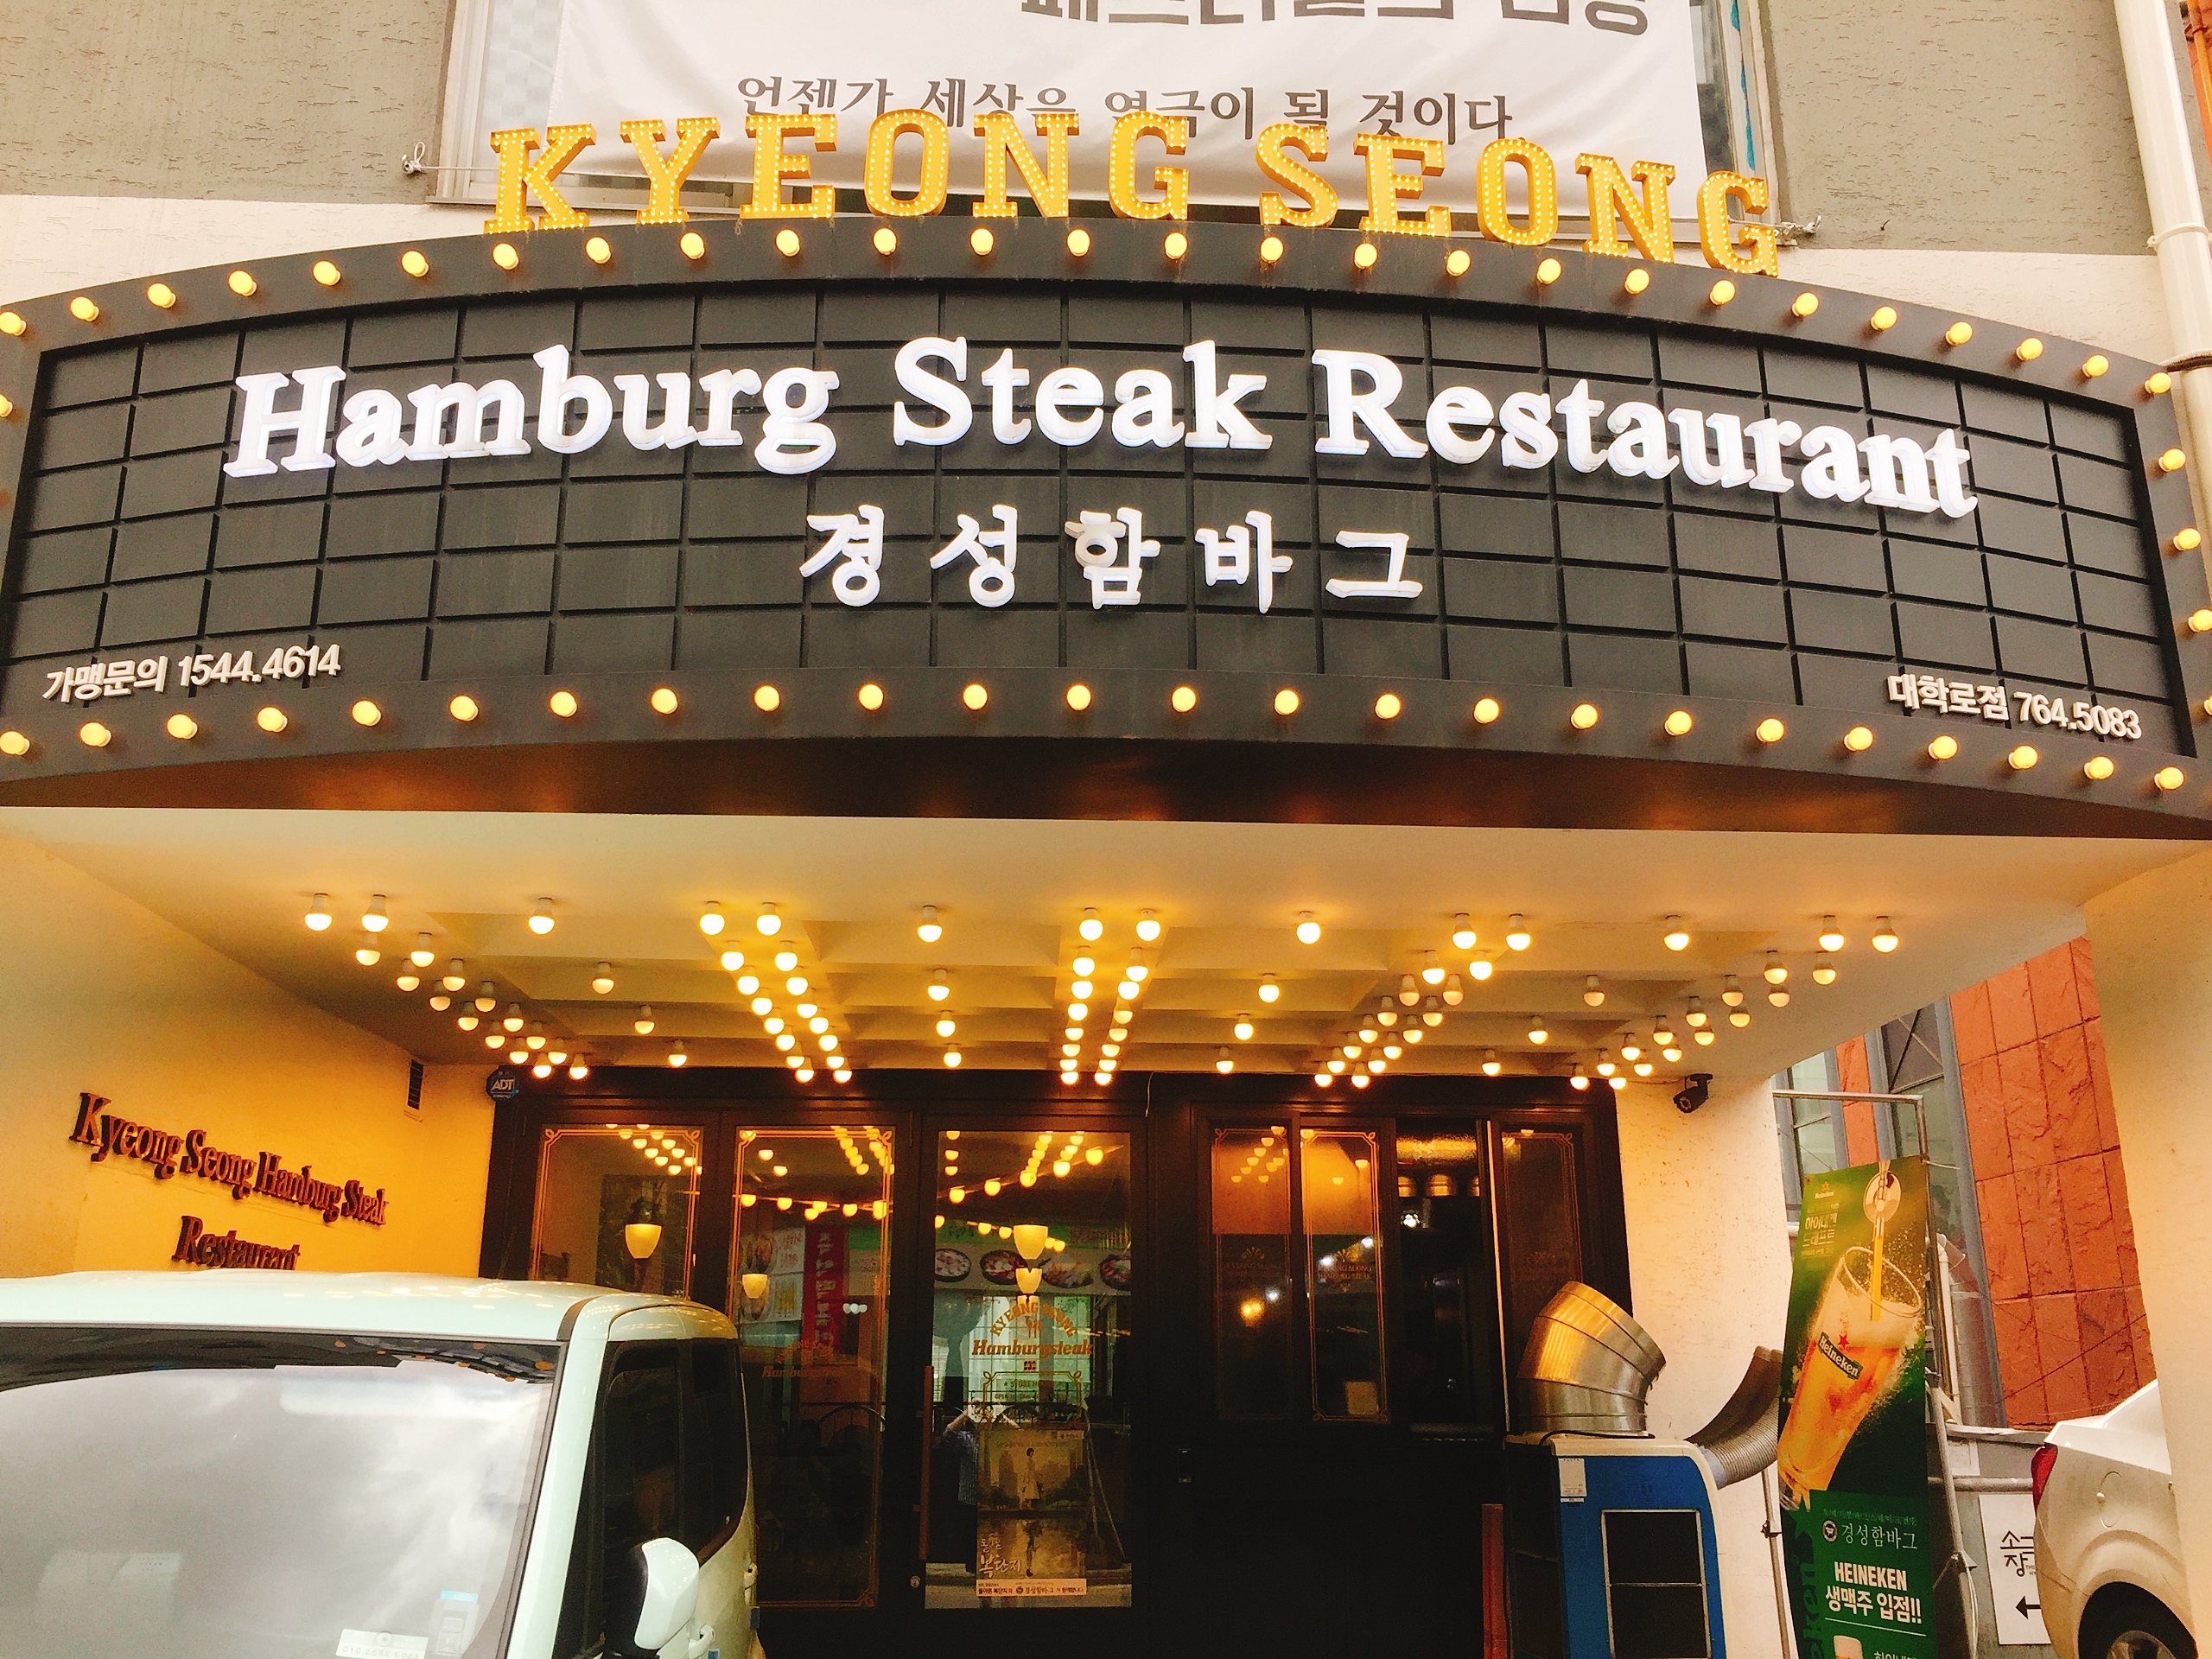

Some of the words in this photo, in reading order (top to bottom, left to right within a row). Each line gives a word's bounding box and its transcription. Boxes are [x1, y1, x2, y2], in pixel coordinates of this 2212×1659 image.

[737, 76, 895, 119] 언젠가
[483, 108, 1190, 234] KYEONG
[1255, 122, 1780, 276] SEONG
[224, 344, 840, 478] Hamburg
[893, 336, 1273, 450] Steak
[1311, 348, 1979, 518] Restaurant
[42, 655, 168, 702] 가맹문의
[177, 644, 342, 687] 1544.4614
[1886, 673, 2010, 724] 대학로점
[2013, 691, 2143, 741] 764.5083
[491, 1078, 515, 1090] ADT
[69, 1092, 184, 1179] Kyeong
[179, 1129, 257, 1200] Seong
[253, 1151, 345, 1223] Hamburg
[341, 1179, 389, 1225] Steak
[171, 1215, 301, 1270] Restaurant
[990, 1301, 1039, 1337] KYEONG
[972, 1339, 1093, 1359] Hamburgsteak
[1819, 1335, 1859, 1376] Heineken
[1841, 1522, 1917, 1549] 경성함바그
[1834, 1561, 1908, 1592] HEINEKEN
[2004, 1553, 2028, 1577] 장
[1825, 1585, 1873, 1617] 생맥주
[1877, 1592, 1923, 1624] 입점!!
